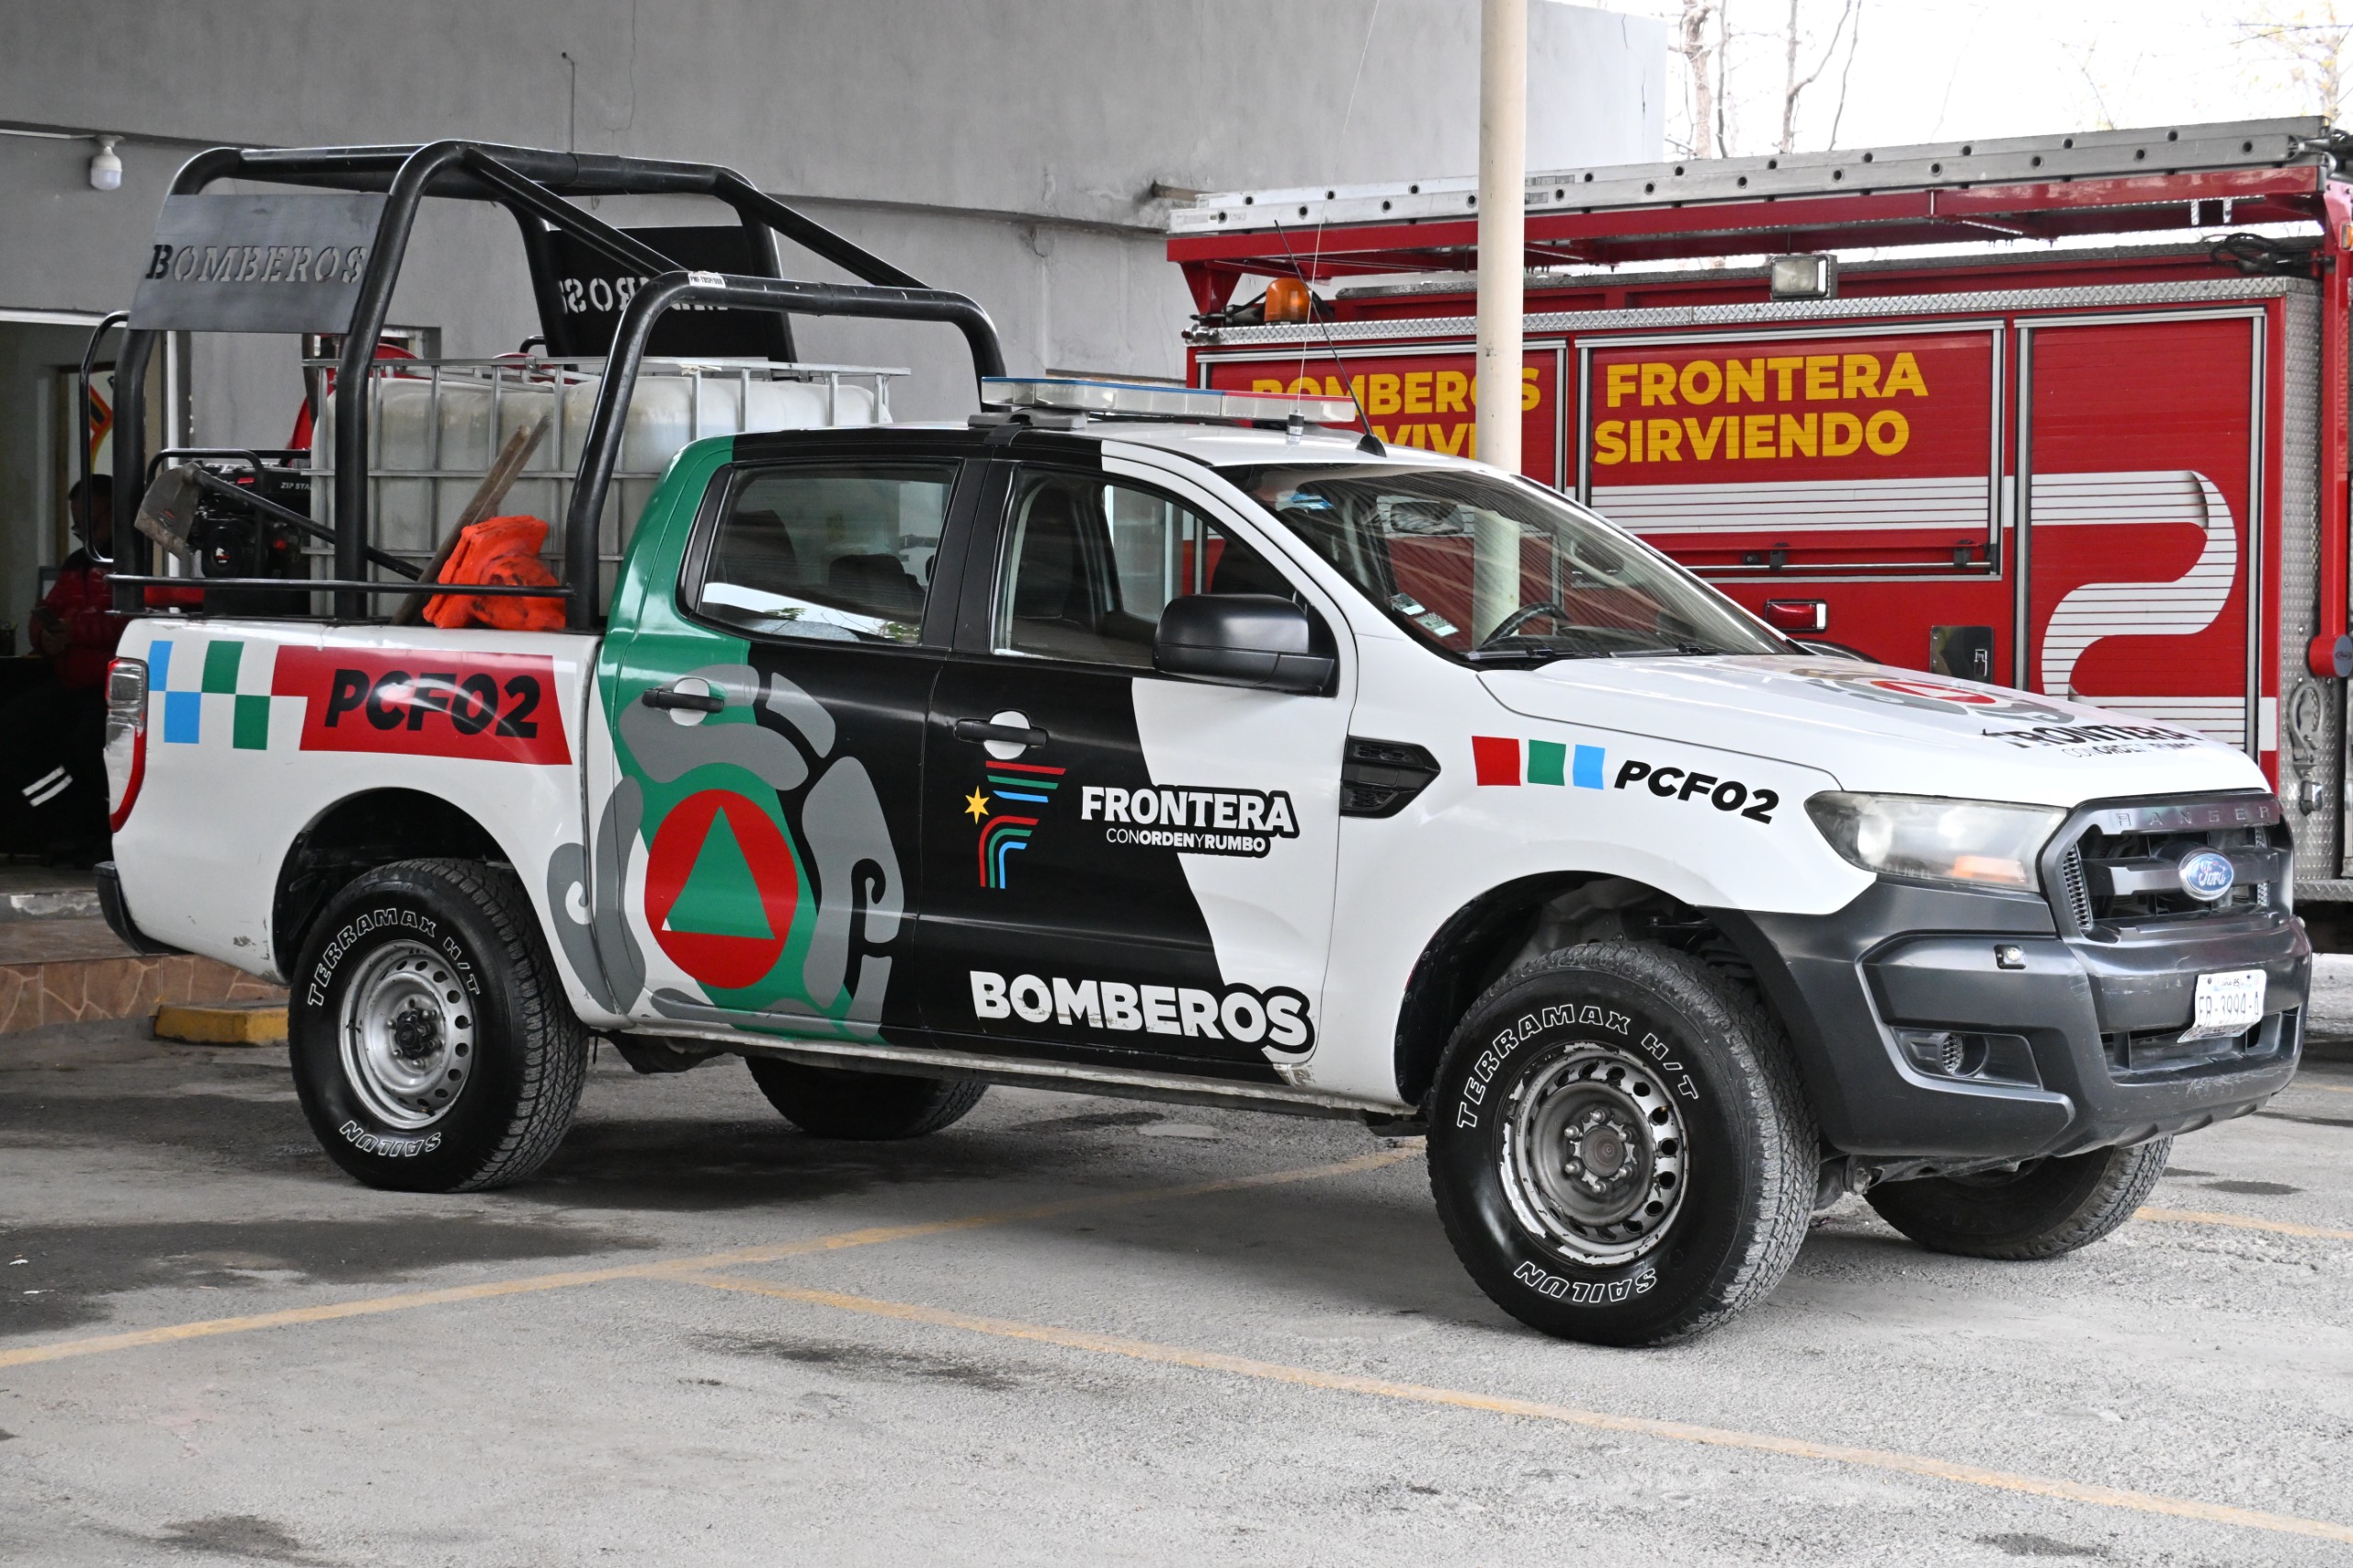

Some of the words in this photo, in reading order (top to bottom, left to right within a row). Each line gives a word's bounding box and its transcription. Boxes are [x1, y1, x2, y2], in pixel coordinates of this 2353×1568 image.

[145, 244, 369, 283] BOMBEROS
[1252, 368, 1540, 416] MBERS
[1607, 351, 1928, 408] FRONTERA
[1594, 410, 1911, 465] SIRVIENDO
[1081, 786, 1295, 833] FRONTERA
[2116, 806, 2271, 826] RANGER
[2198, 859, 2228, 887] Ford
[308, 907, 436, 1006] TERRAMAX
[443, 937, 480, 995] H/T
[969, 970, 1309, 1046] BOMBEROS
[1457, 1004, 1631, 1131] TERRAMAX
[1641, 1032, 1699, 1100] H/T
[339, 1119, 441, 1158] SAILUN
[1514, 1261, 1657, 1303] SAILUN
